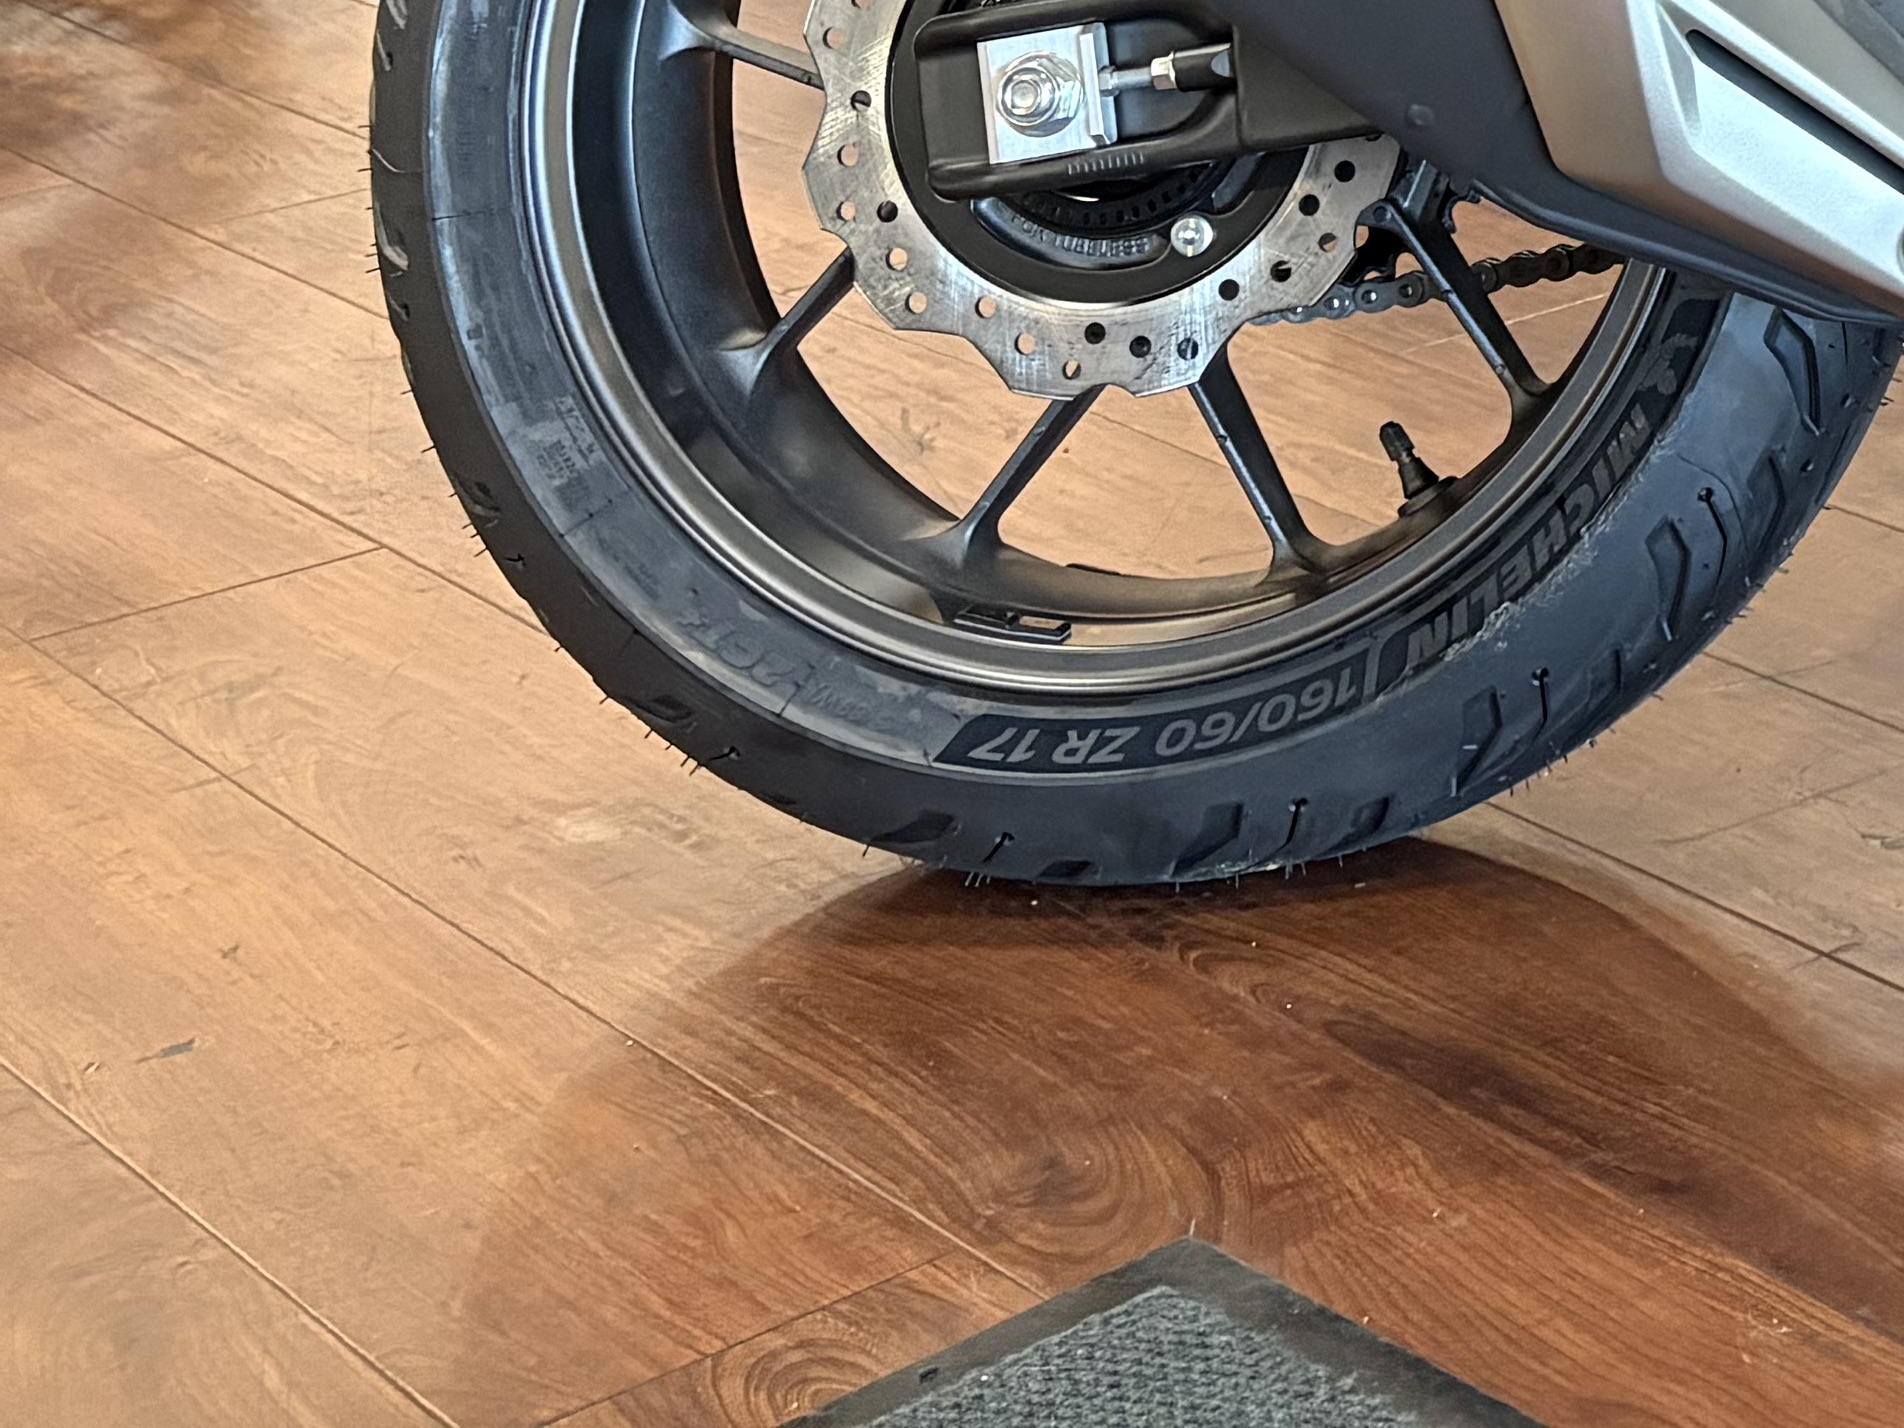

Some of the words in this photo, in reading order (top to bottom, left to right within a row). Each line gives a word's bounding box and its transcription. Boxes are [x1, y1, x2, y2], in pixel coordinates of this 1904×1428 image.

[1406, 406, 1652, 666] MICHELIN
[968, 724, 1042, 765] 17
[1052, 726, 1138, 766] ZR
[1155, 682, 1363, 758] 160/60
